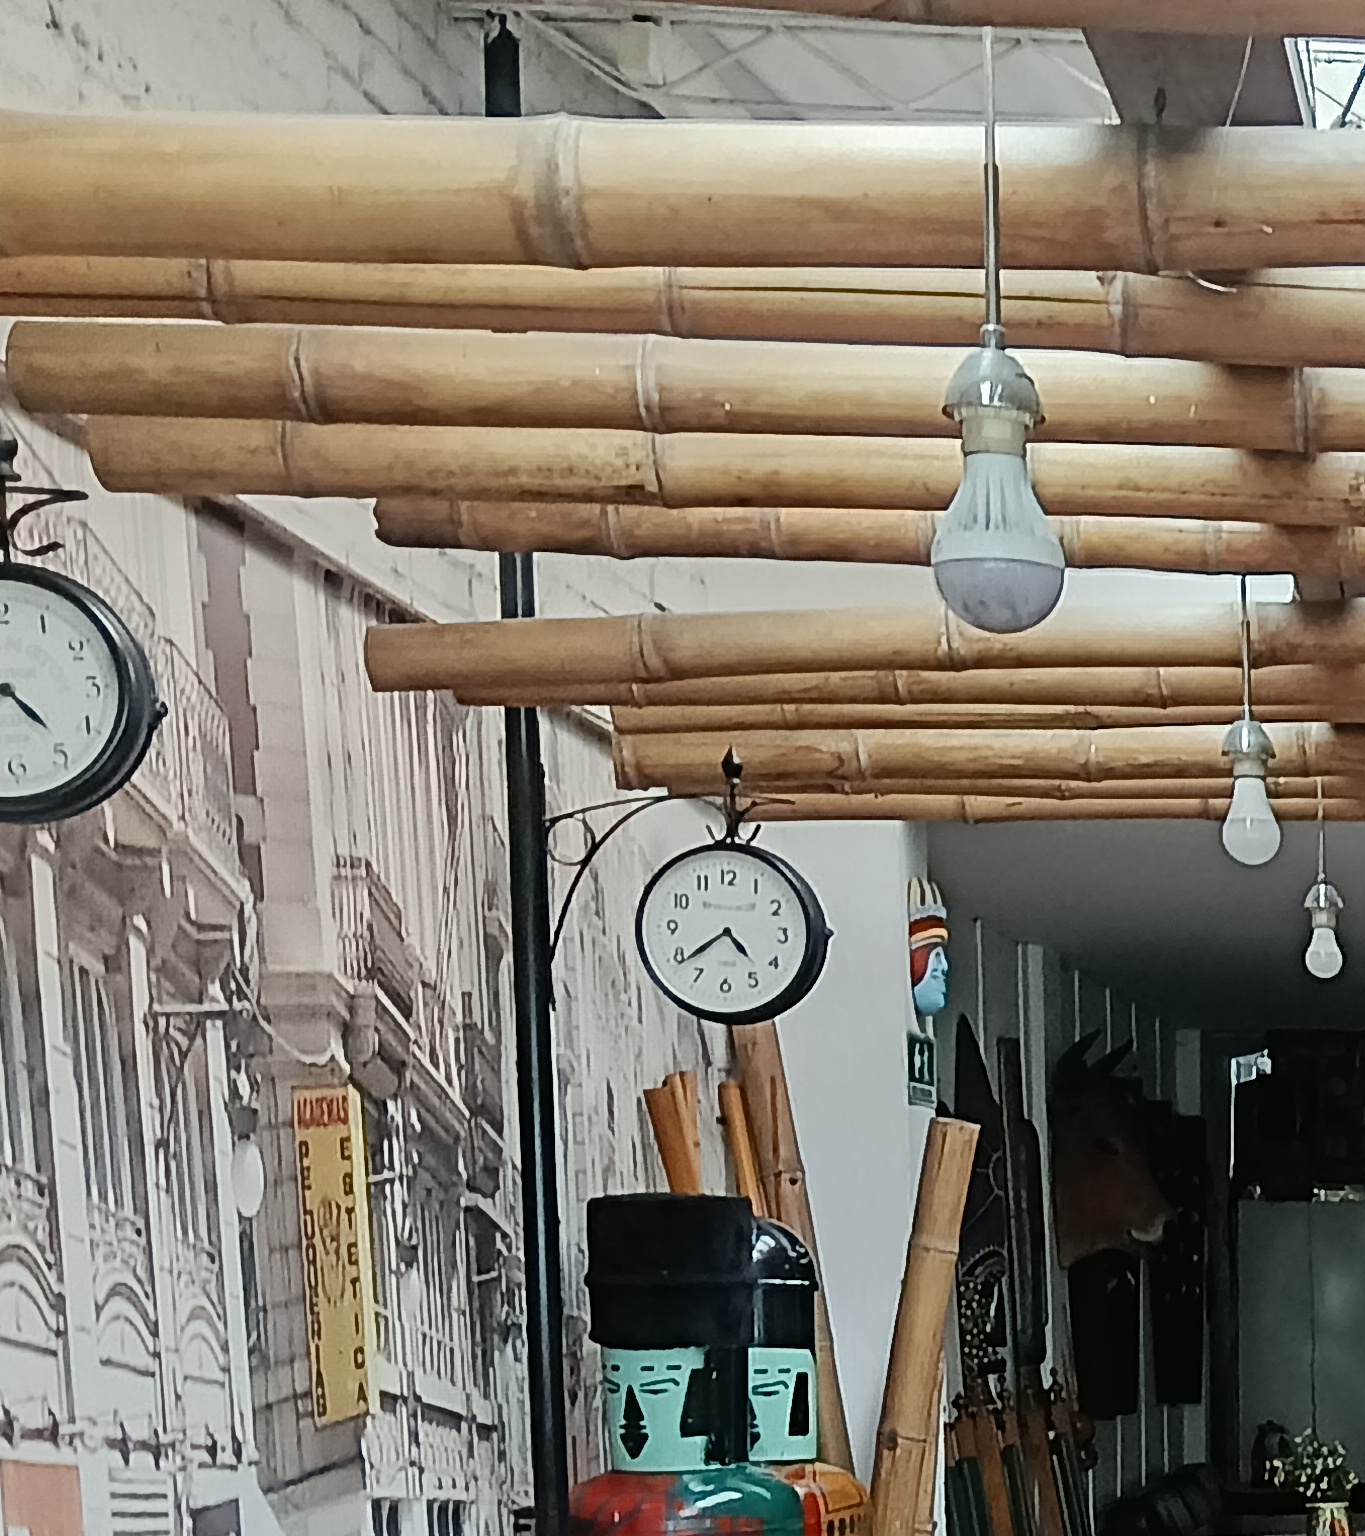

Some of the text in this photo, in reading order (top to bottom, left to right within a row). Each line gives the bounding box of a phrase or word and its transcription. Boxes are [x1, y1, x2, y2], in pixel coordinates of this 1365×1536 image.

[68, 639, 84, 662] 2
[85, 675, 100, 699] 3
[53, 742, 69, 771] 5
[7, 754, 27, 778] 6
[696, 874, 709, 892] 11
[720, 868, 737, 886] 12
[673, 892, 690, 910] 10
[769, 899, 782, 917] 2
[666, 919, 679, 936] 9
[776, 926, 789, 944] 3
[673, 946, 686, 965] 8
[768, 955, 779, 970] 4
[693, 966, 705, 983] 7
[747, 971, 759, 989] 5
[719, 975, 732, 994] 6
